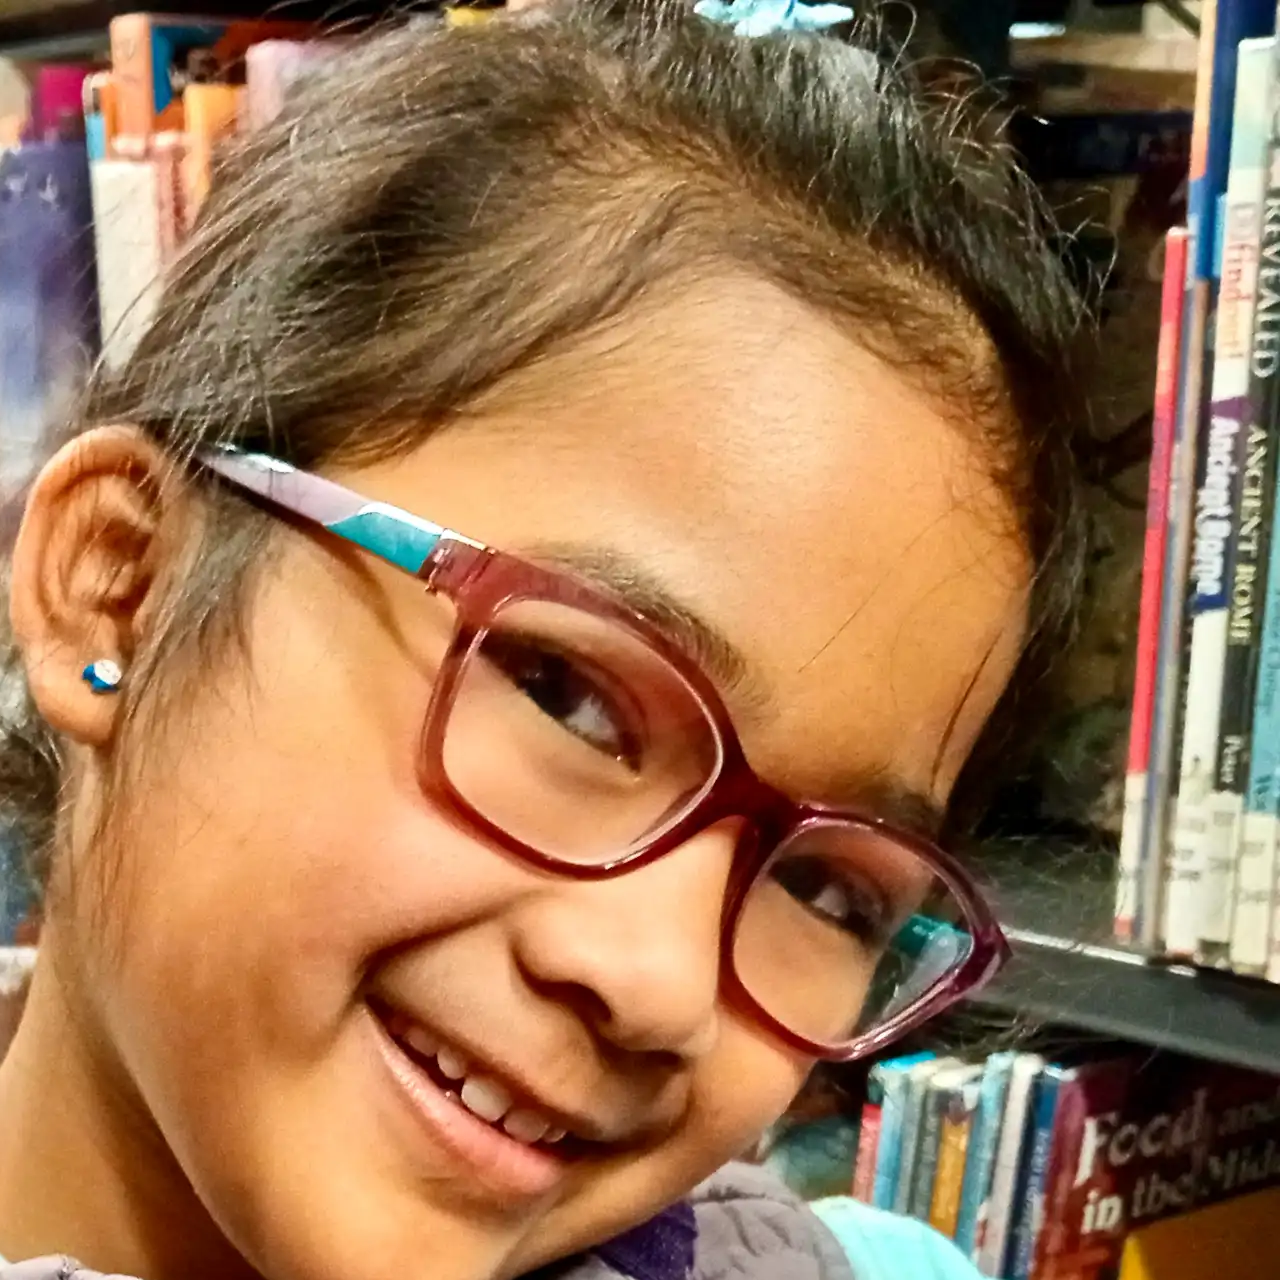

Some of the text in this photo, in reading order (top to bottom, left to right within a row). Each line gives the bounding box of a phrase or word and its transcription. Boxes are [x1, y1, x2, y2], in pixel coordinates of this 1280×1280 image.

[1230, 422, 1268, 643] ANCIENT ROME
[1073, 1087, 1208, 1189] Food
[1080, 1190, 1122, 1235] in
